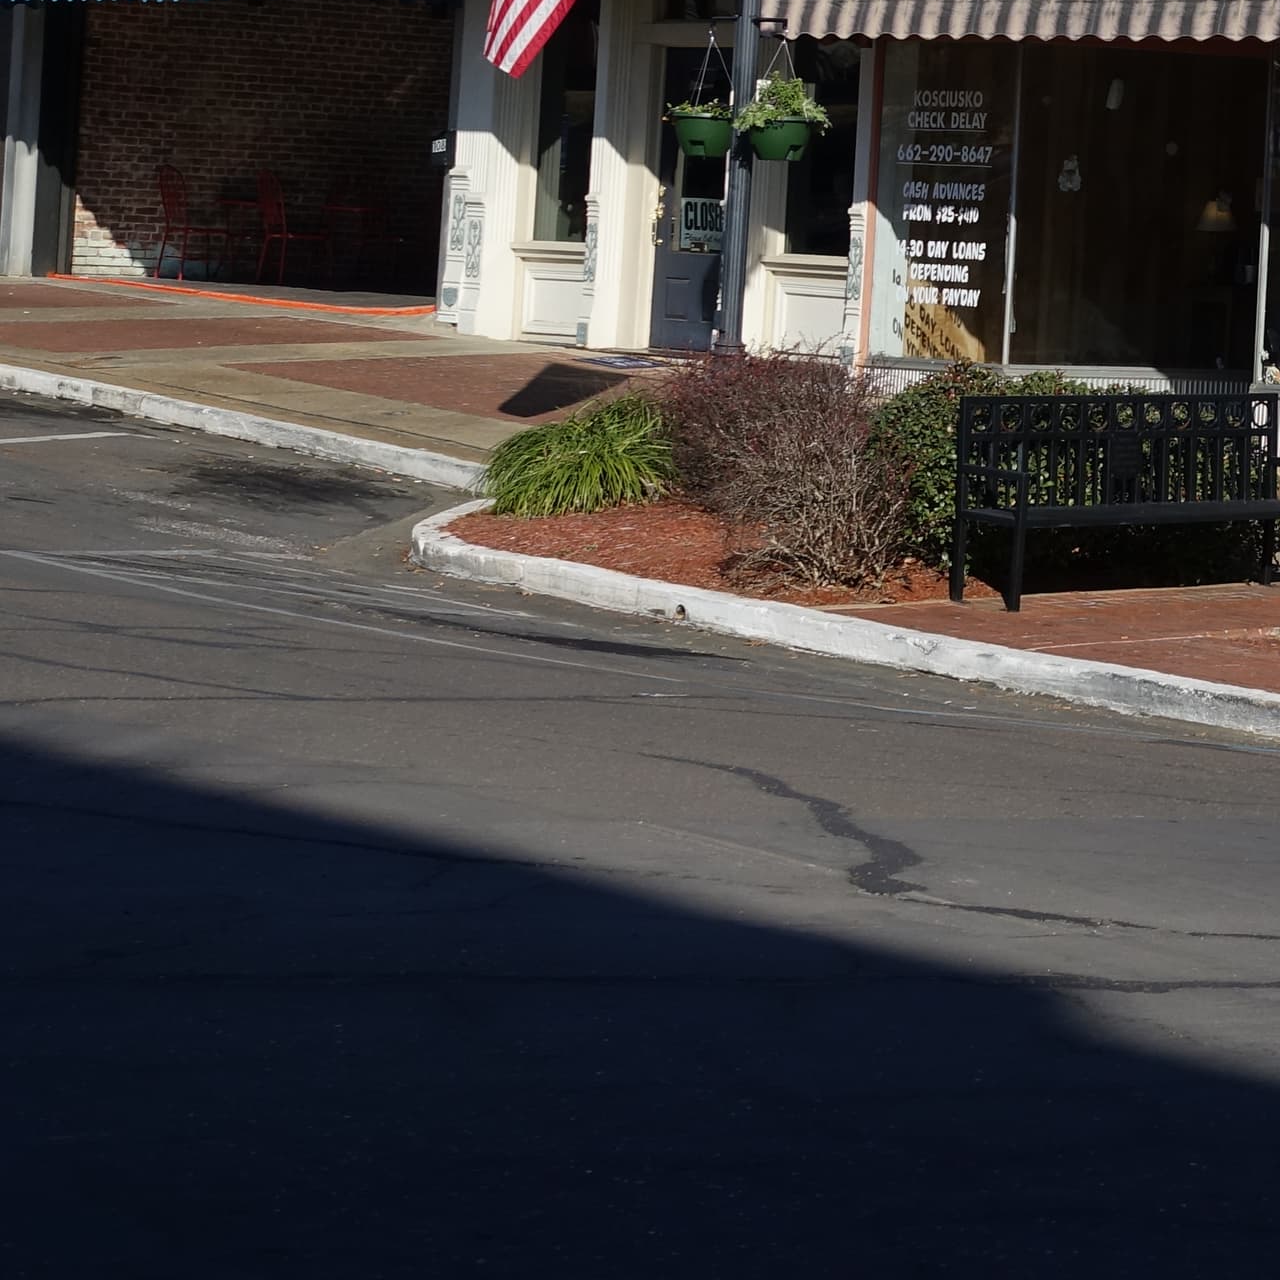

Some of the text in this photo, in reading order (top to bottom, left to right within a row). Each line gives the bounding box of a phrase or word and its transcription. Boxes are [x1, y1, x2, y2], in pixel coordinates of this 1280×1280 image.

[913, 89, 984, 109] KOSCIUSKO
[907, 111, 988, 130] CHECK DELAY
[897, 143, 993, 164] 662-290-8647
[903, 181, 985, 202] CASH ADVANCES
[684, 201, 723, 232] CLOSE
[902, 203, 980, 227] FROM $25-$410
[927, 240, 949, 259] DAY
[952, 241, 987, 262] LOANS
[910, 262, 969, 284] DEPENDING
[913, 286, 939, 305] YOUR
[942, 288, 981, 308] PAYDAY
